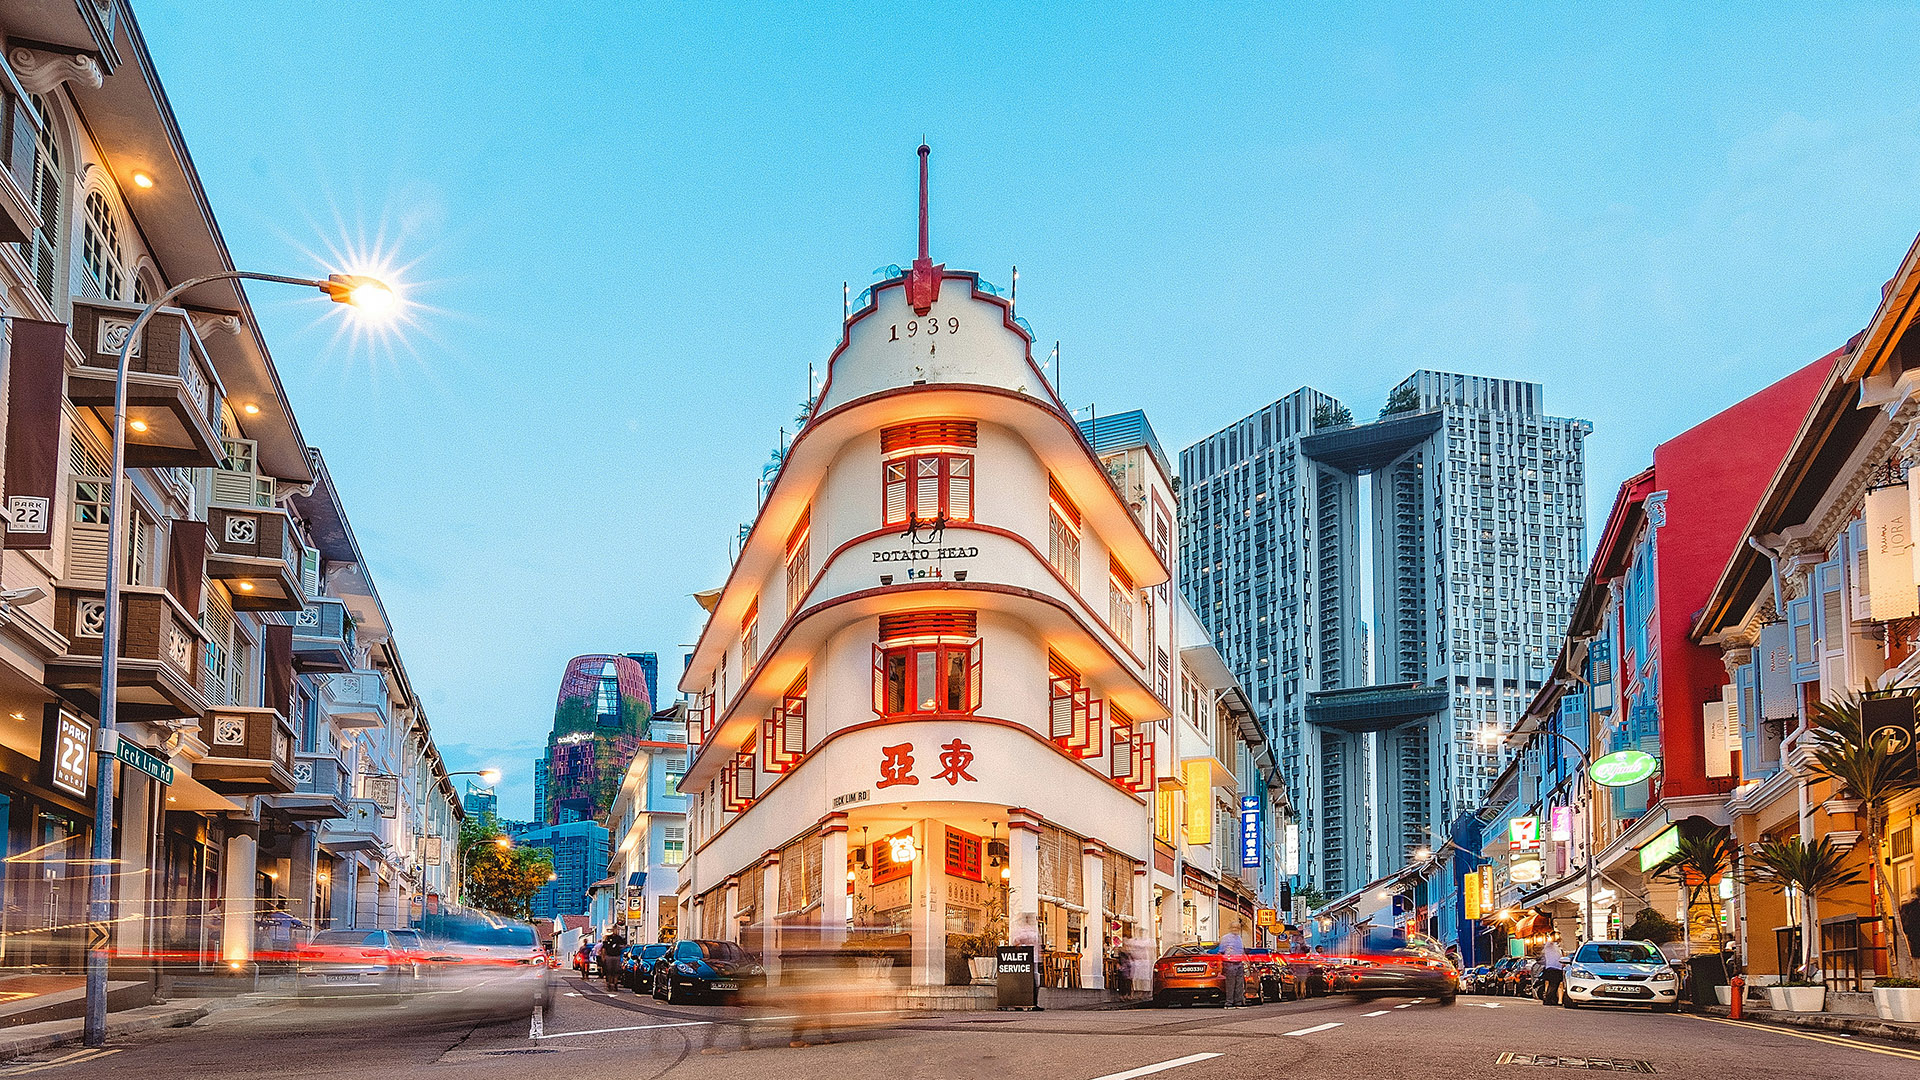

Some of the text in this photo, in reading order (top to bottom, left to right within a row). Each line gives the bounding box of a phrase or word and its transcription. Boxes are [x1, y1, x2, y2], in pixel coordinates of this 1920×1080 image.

[888, 317, 959, 342] 1939
[15, 508, 40, 523] 22
[1890, 515, 1905, 557] LIORA
[872, 546, 979, 563] POTATO HEAD
[907, 565, 943, 580] Folk
[61, 720, 87, 744] PARK
[60, 737, 85, 776] 22
[119, 741, 171, 783] Teck Lim Rd
[58, 769, 83, 788] hotel
[845, 793, 856, 803] LIM
[858, 791, 867, 801] RD
[1000, 952, 1029, 962] VALET
[998, 964, 1031, 973] SERVICE
